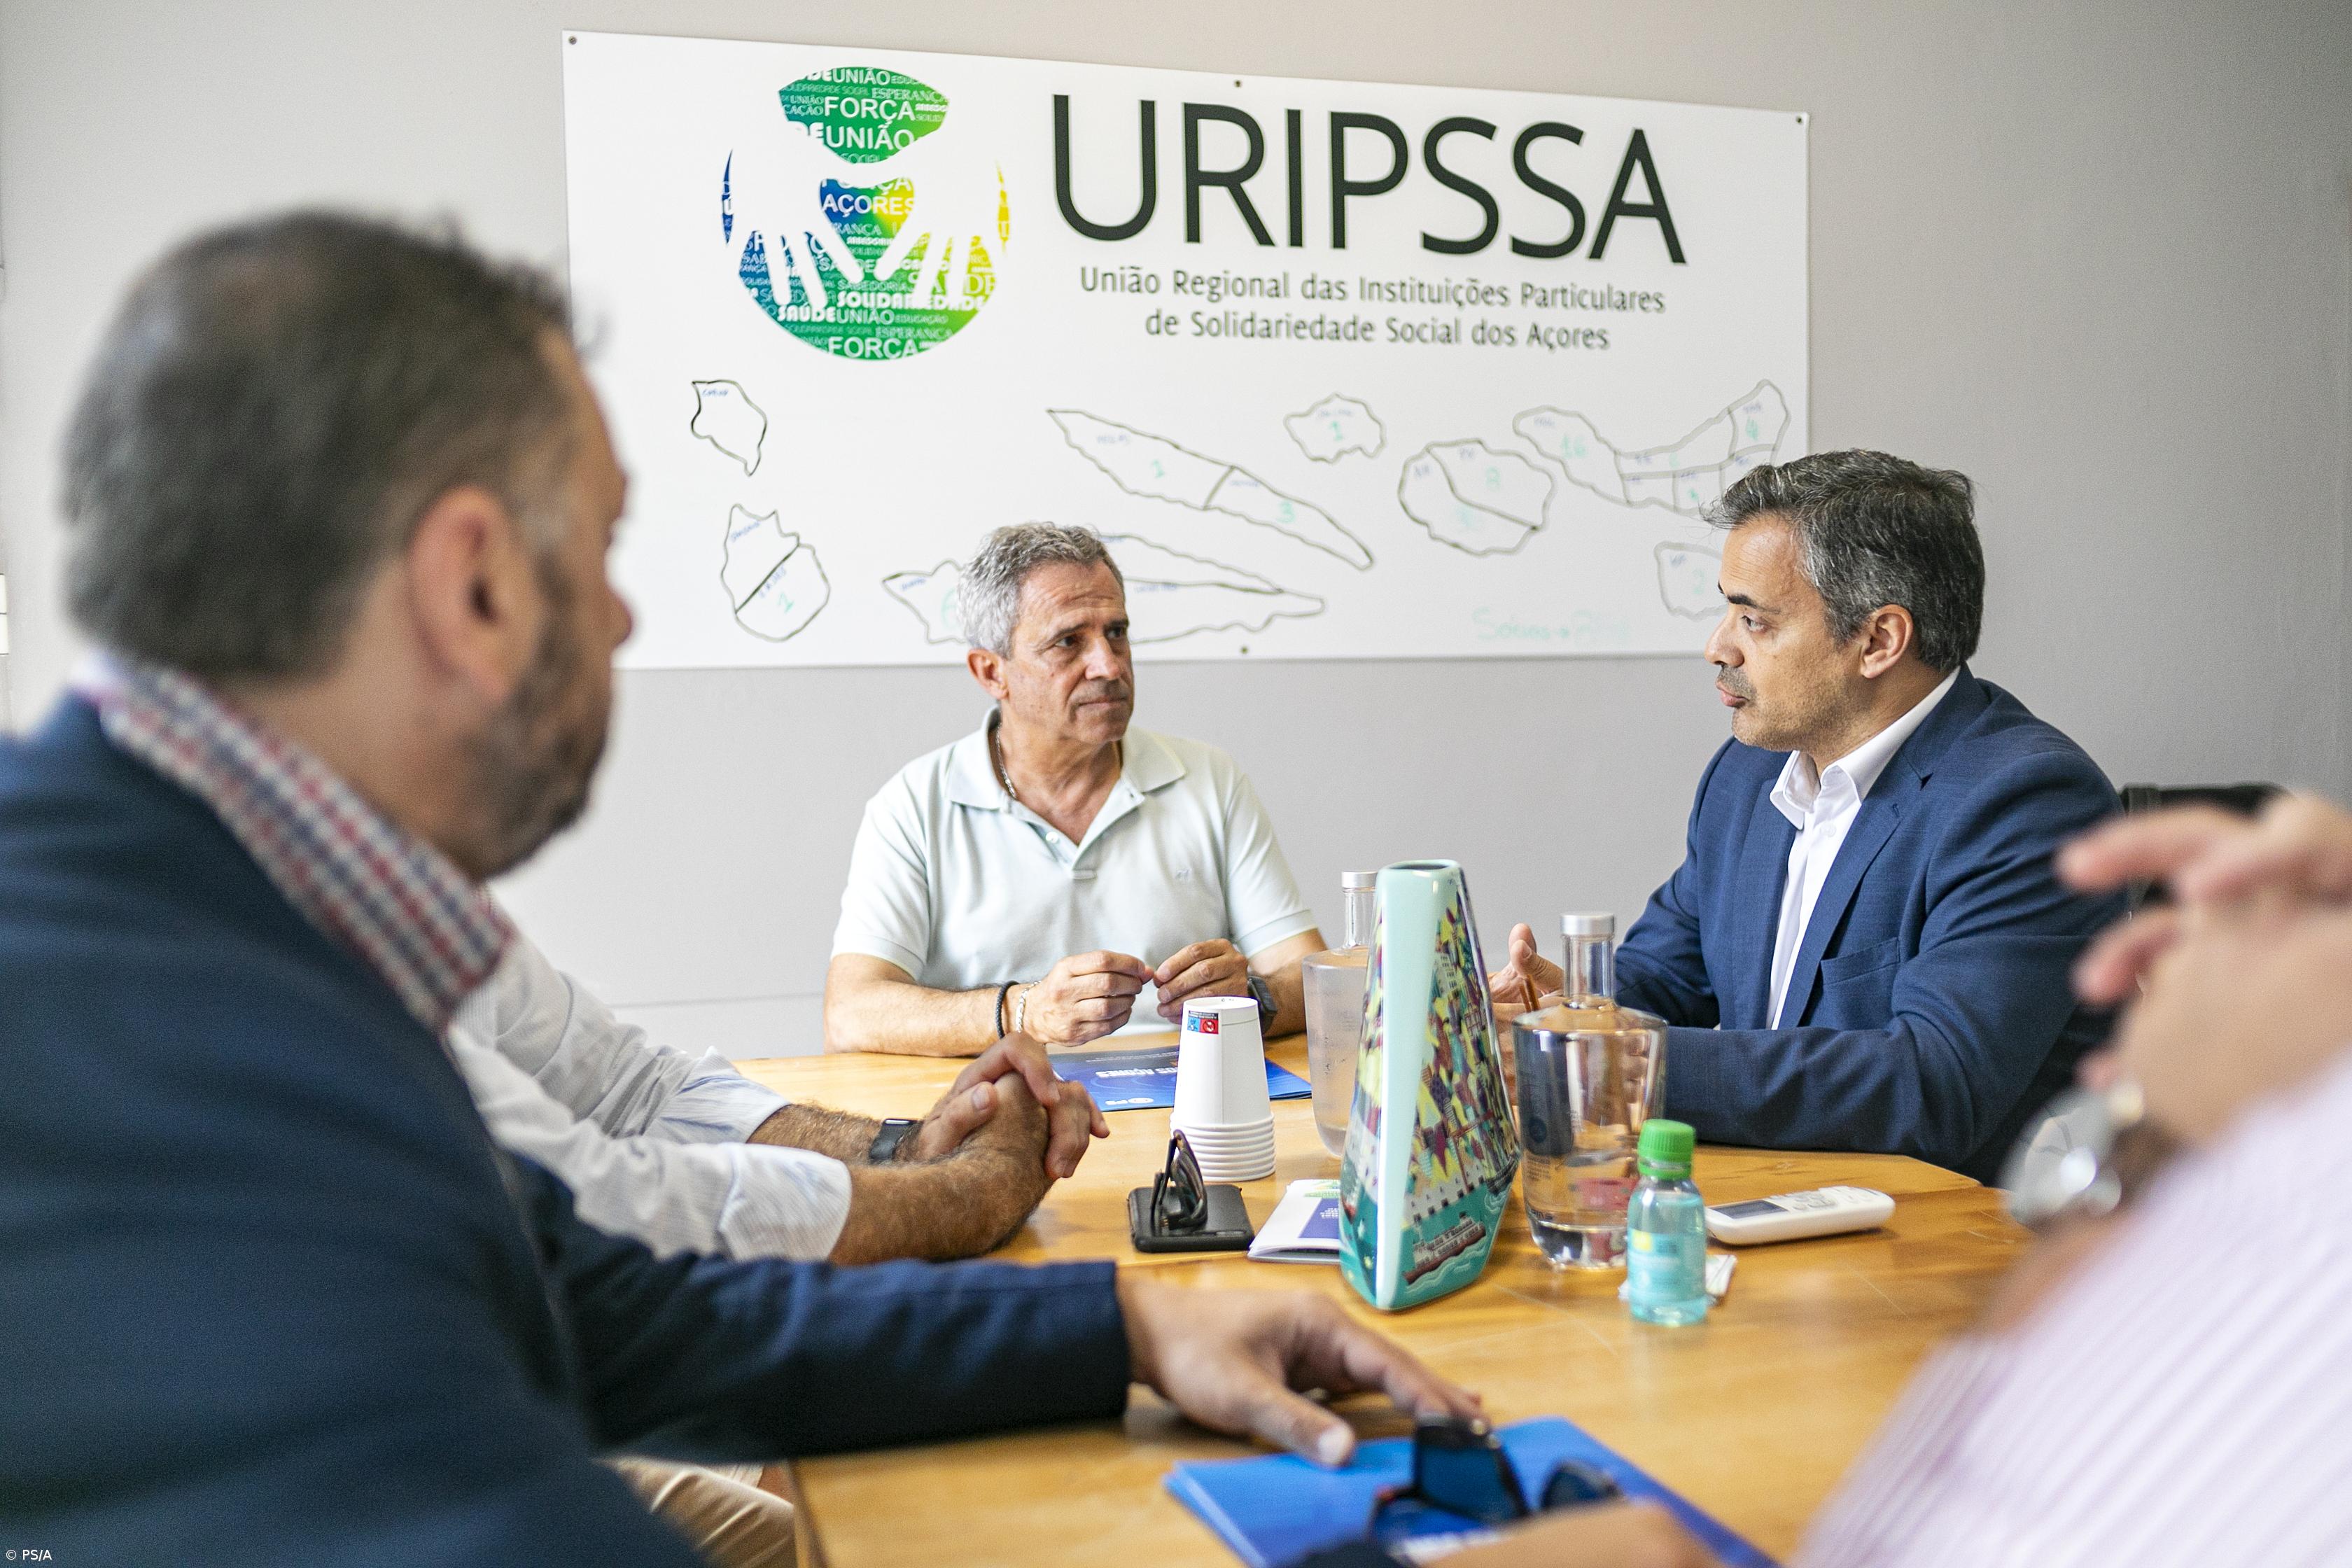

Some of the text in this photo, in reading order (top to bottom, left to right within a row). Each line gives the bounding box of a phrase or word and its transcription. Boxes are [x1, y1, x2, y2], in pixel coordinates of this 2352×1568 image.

[832, 68, 891, 85] UNIÃO
[824, 96, 916, 126] FORÇA
[826, 124, 914, 150] UNIÃO
[1054, 94, 1687, 265] URIPSSA
[822, 193, 914, 218] AÇORES
[1080, 266, 1666, 314] União Regional das Instituições Particulares
[777, 302, 836, 323] SAÚDE
[836, 307, 894, 326] UNIÃO
[1145, 308, 1611, 352] de Solidariedade Social dos Açores
